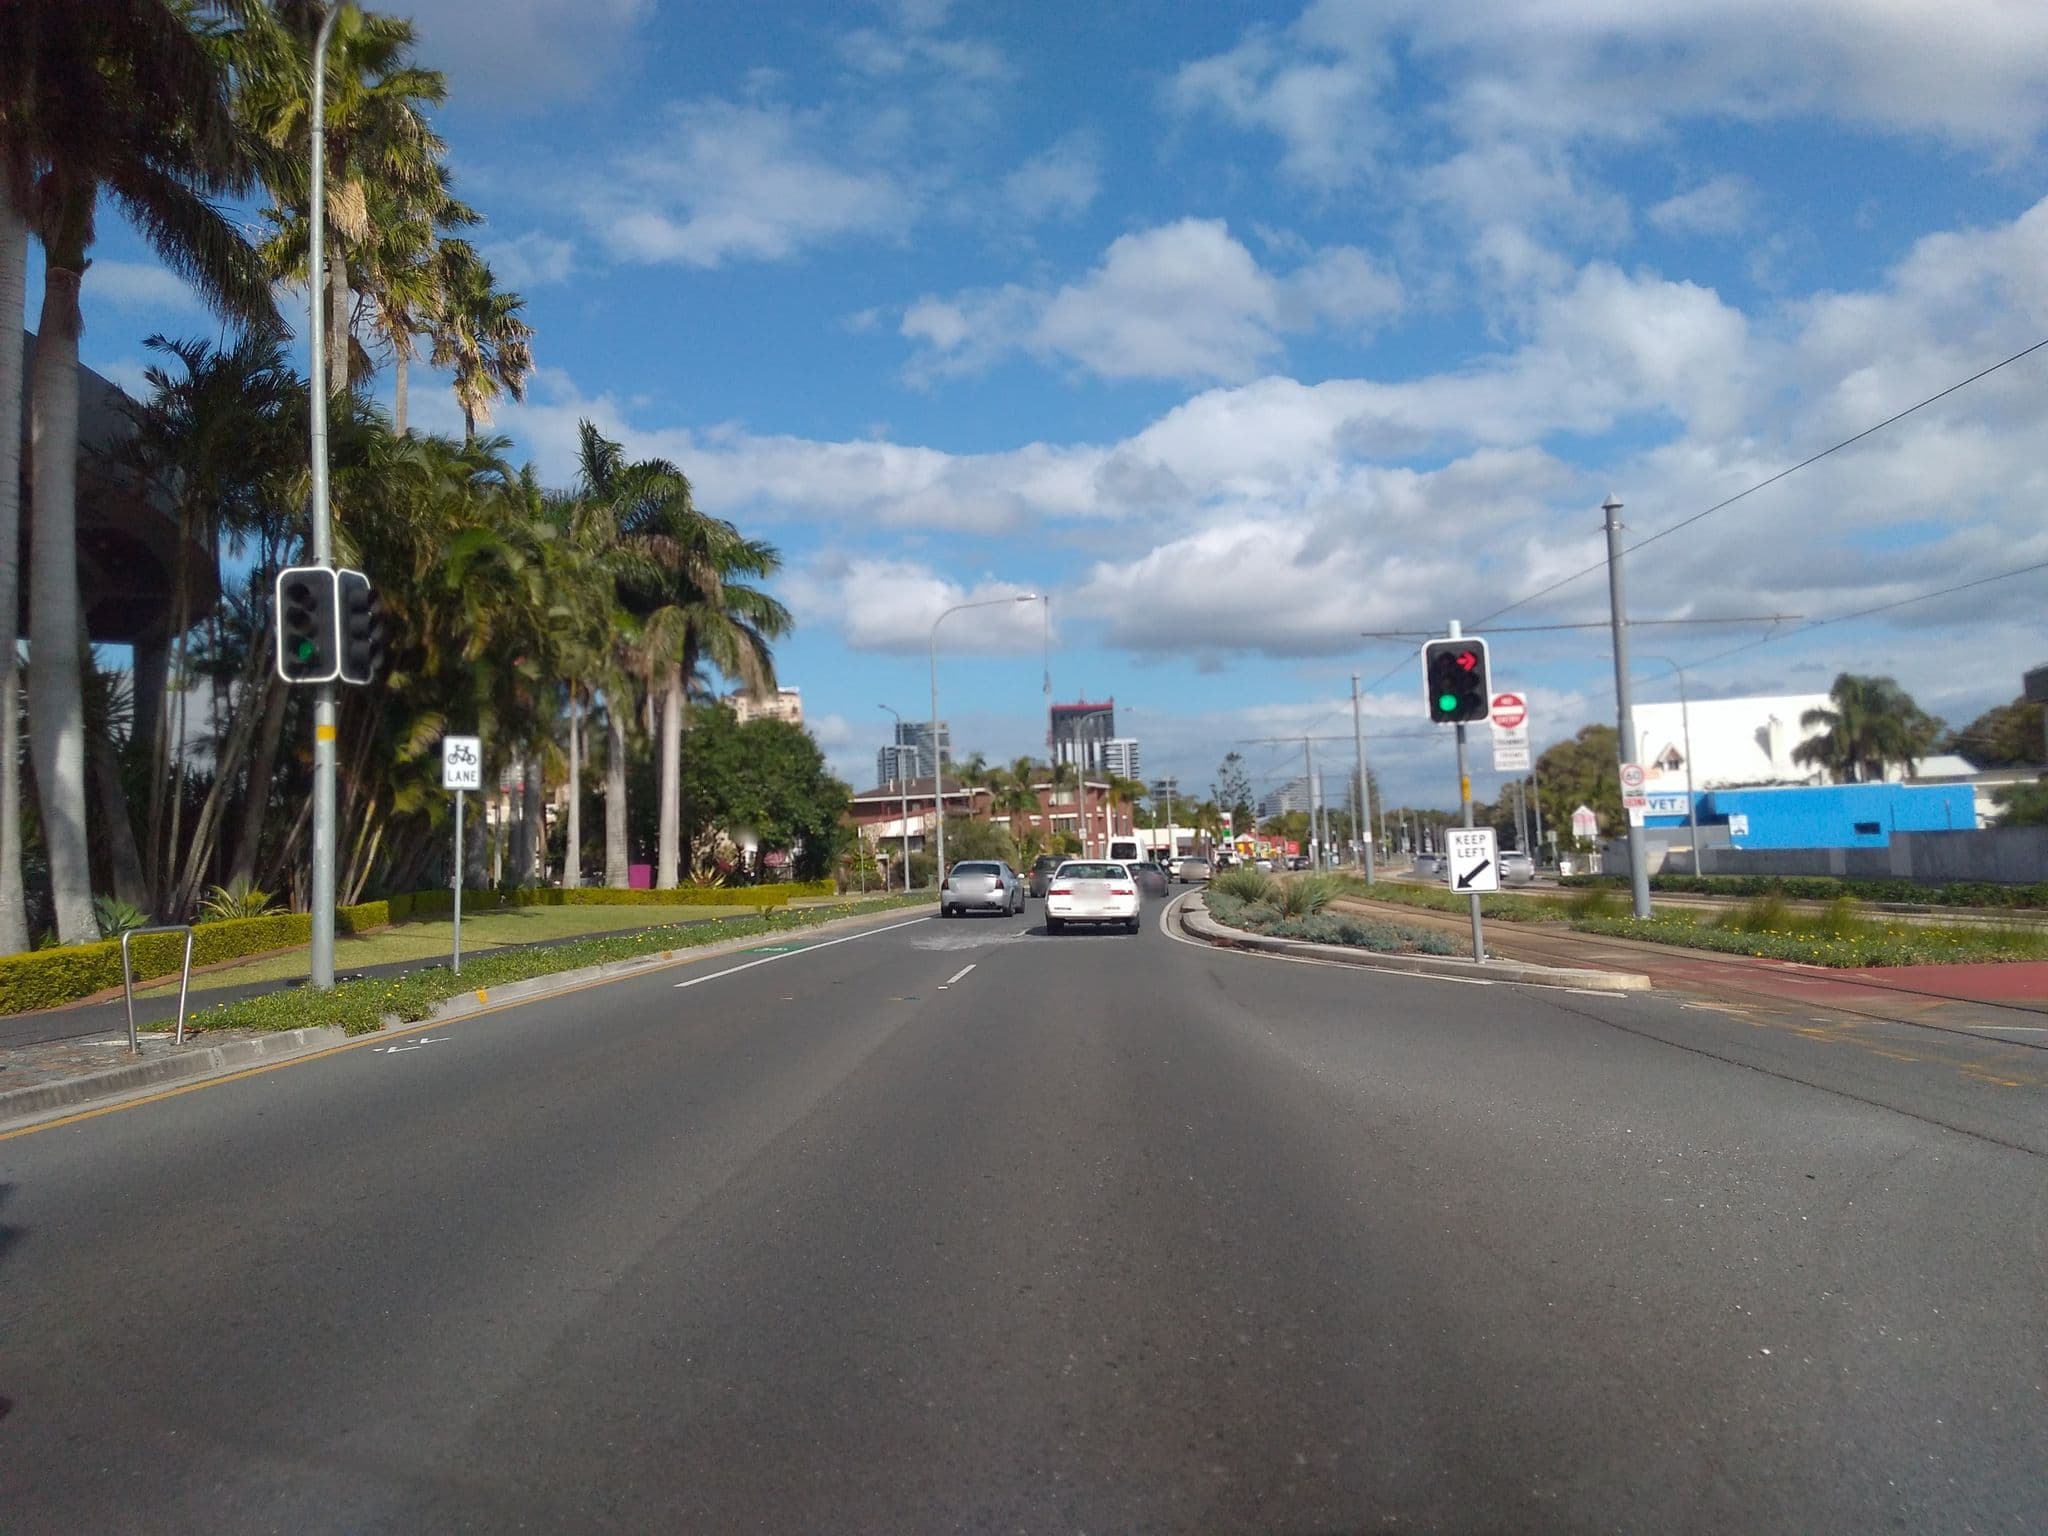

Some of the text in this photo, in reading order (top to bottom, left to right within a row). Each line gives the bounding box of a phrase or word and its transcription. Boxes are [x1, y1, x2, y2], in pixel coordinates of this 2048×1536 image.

[447, 770, 477, 782] LANE
[1626, 770, 1641, 780] 60
[1648, 798, 1678, 810] VET
[1456, 834, 1486, 845] KEEP
[1457, 847, 1486, 858] LEFT
